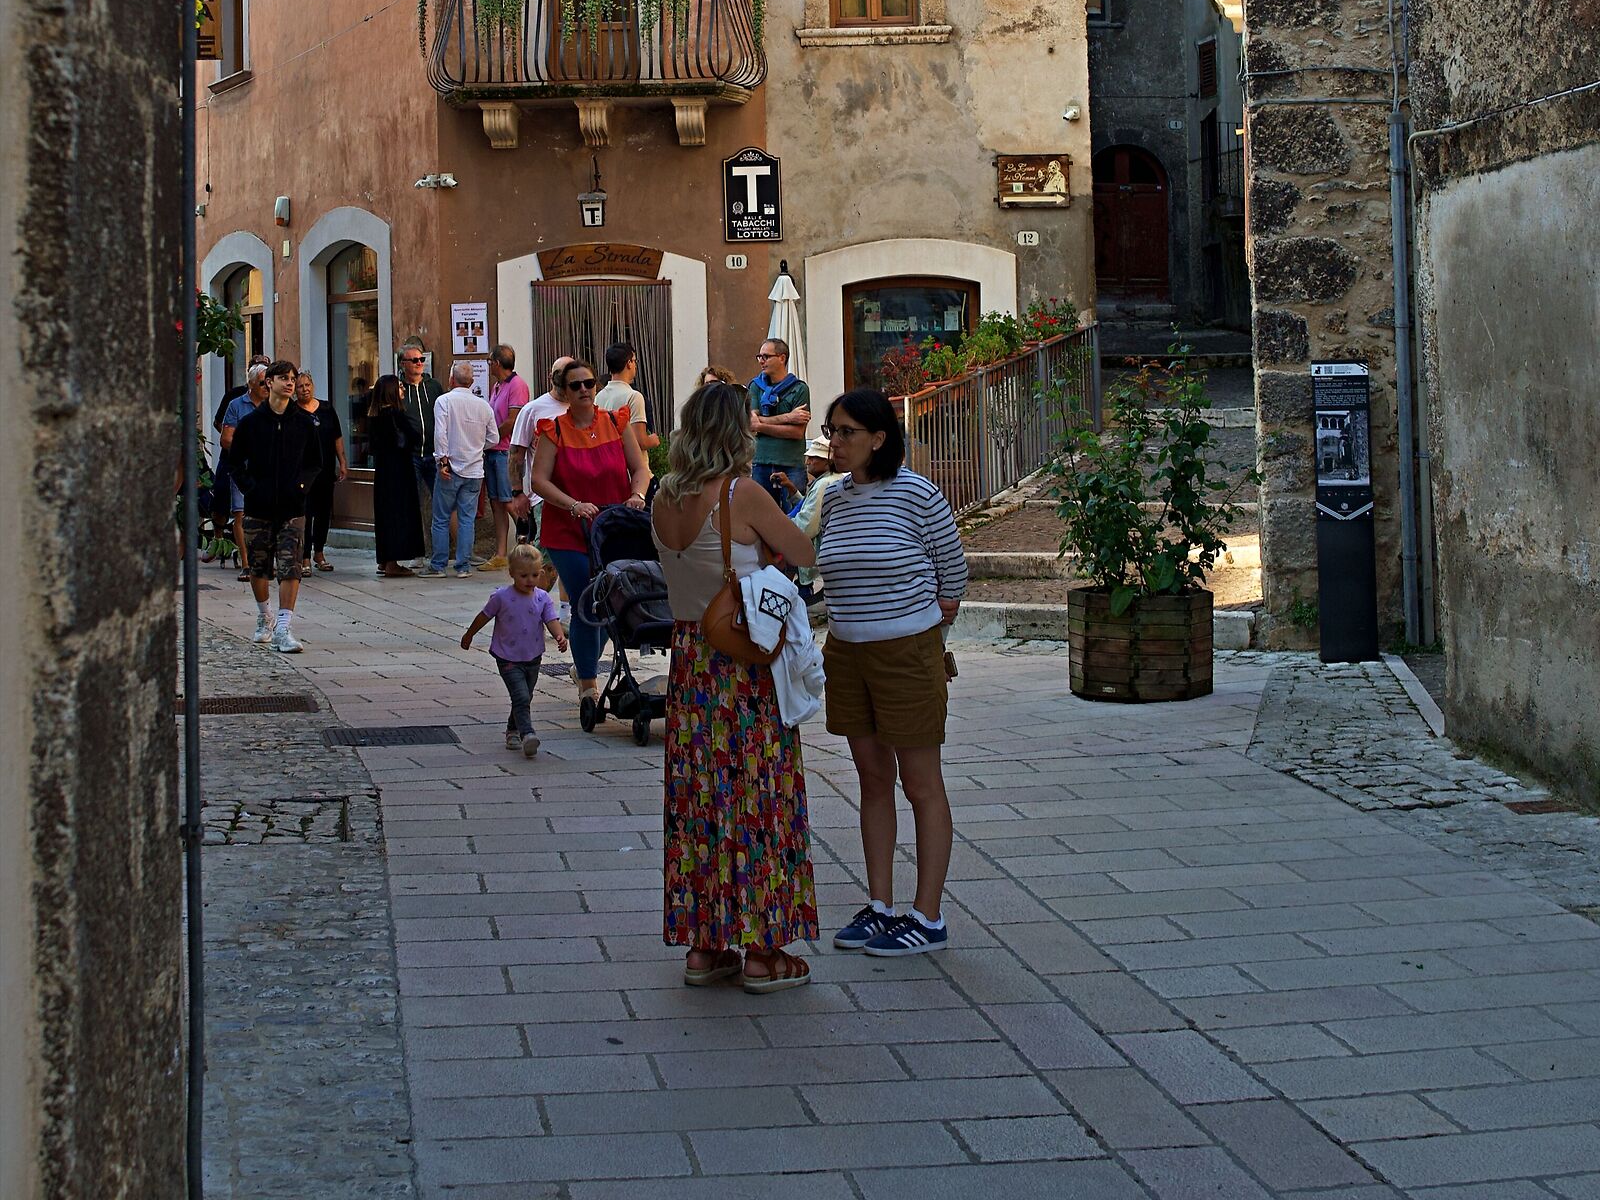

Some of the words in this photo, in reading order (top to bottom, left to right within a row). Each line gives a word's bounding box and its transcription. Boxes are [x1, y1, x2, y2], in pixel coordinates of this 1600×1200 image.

[1003, 163, 1016, 173] La
[732, 165, 771, 212] T
[731, 219, 775, 228] TABACCHI
[737, 230, 770, 238] LOTTO
[1023, 233, 1033, 243] 12
[546, 247, 575, 270] La
[584, 245, 653, 265] Strada
[731, 256, 742, 267] 10
